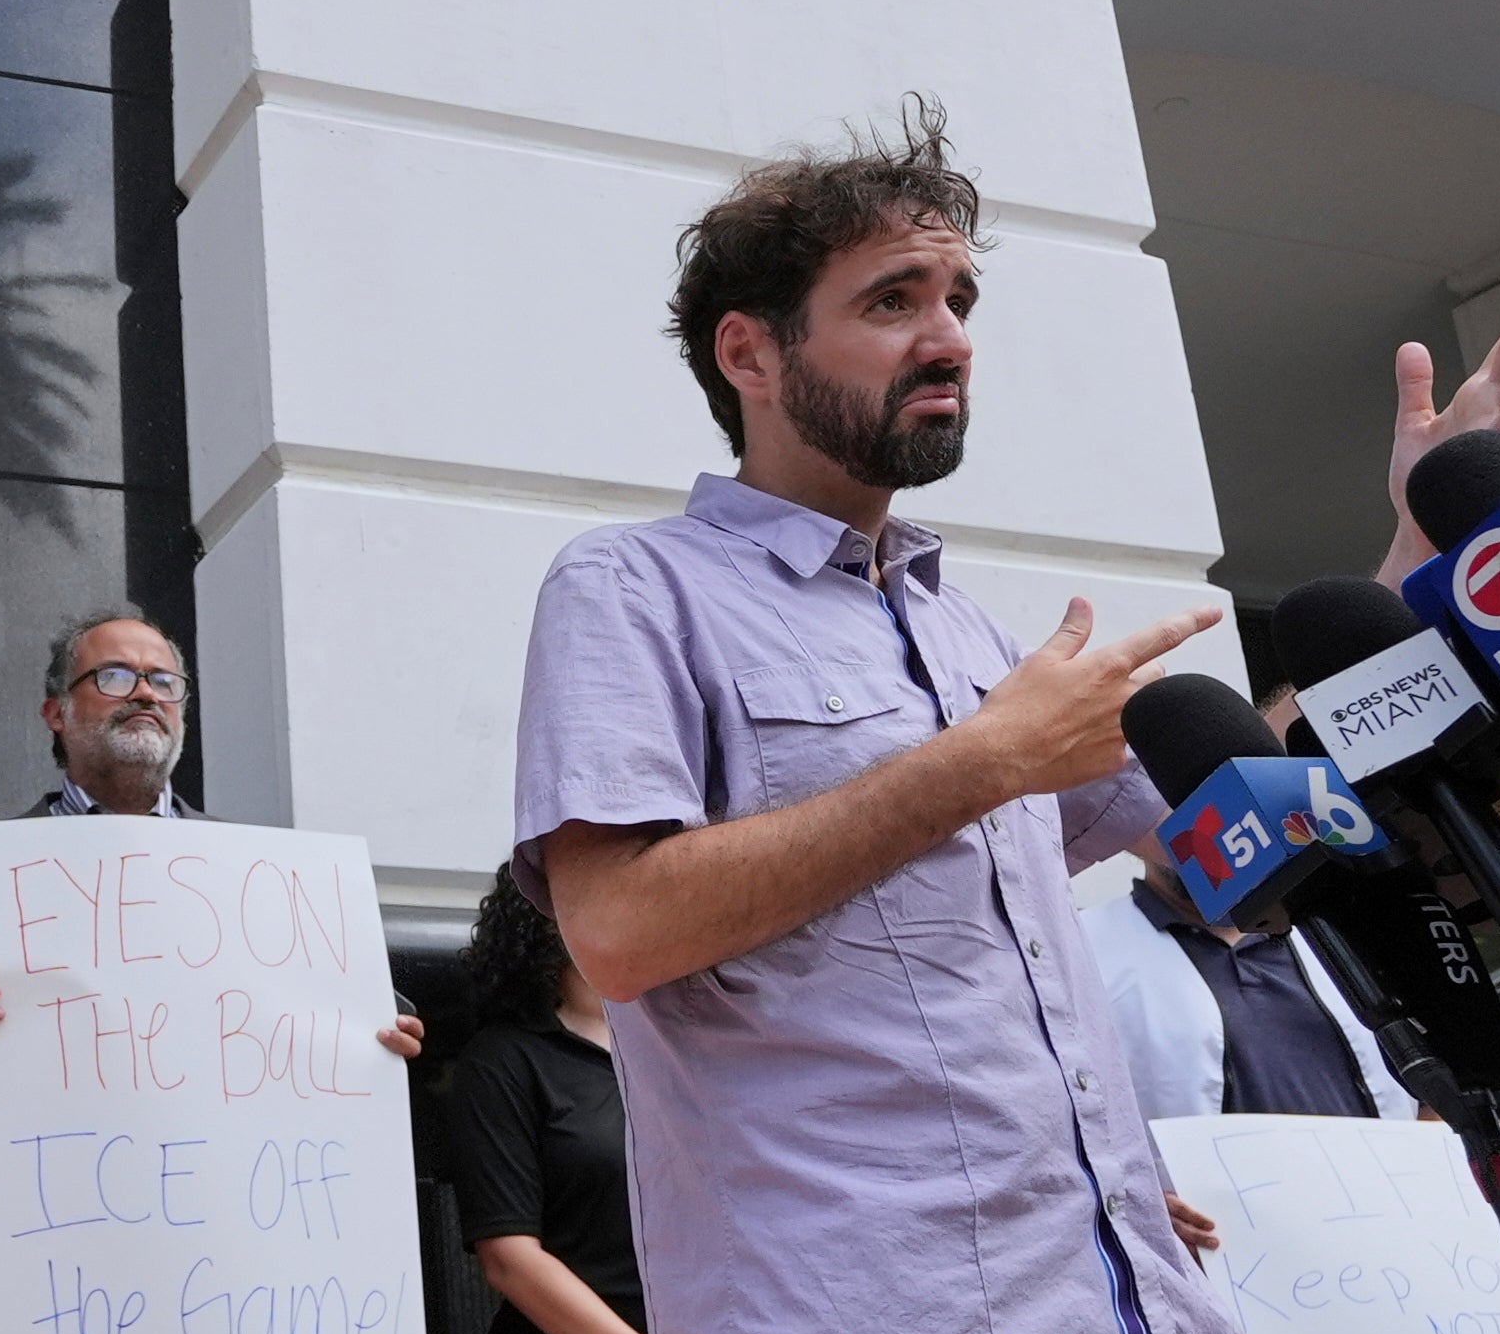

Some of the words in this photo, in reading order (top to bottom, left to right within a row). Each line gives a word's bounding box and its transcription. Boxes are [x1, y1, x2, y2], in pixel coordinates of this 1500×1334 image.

[1337, 676, 1459, 747] MIAMI
[1346, 691, 1385, 716] CBS
[1382, 664, 1442, 699] NEWS
[1221, 809, 1273, 868] 51
[1307, 766, 1375, 845] 6
[9, 853, 223, 974] EYES
[240, 858, 349, 974] ON
[9, 1131, 208, 1238] ICE
[1223, 1251, 1411, 1334] Keep
